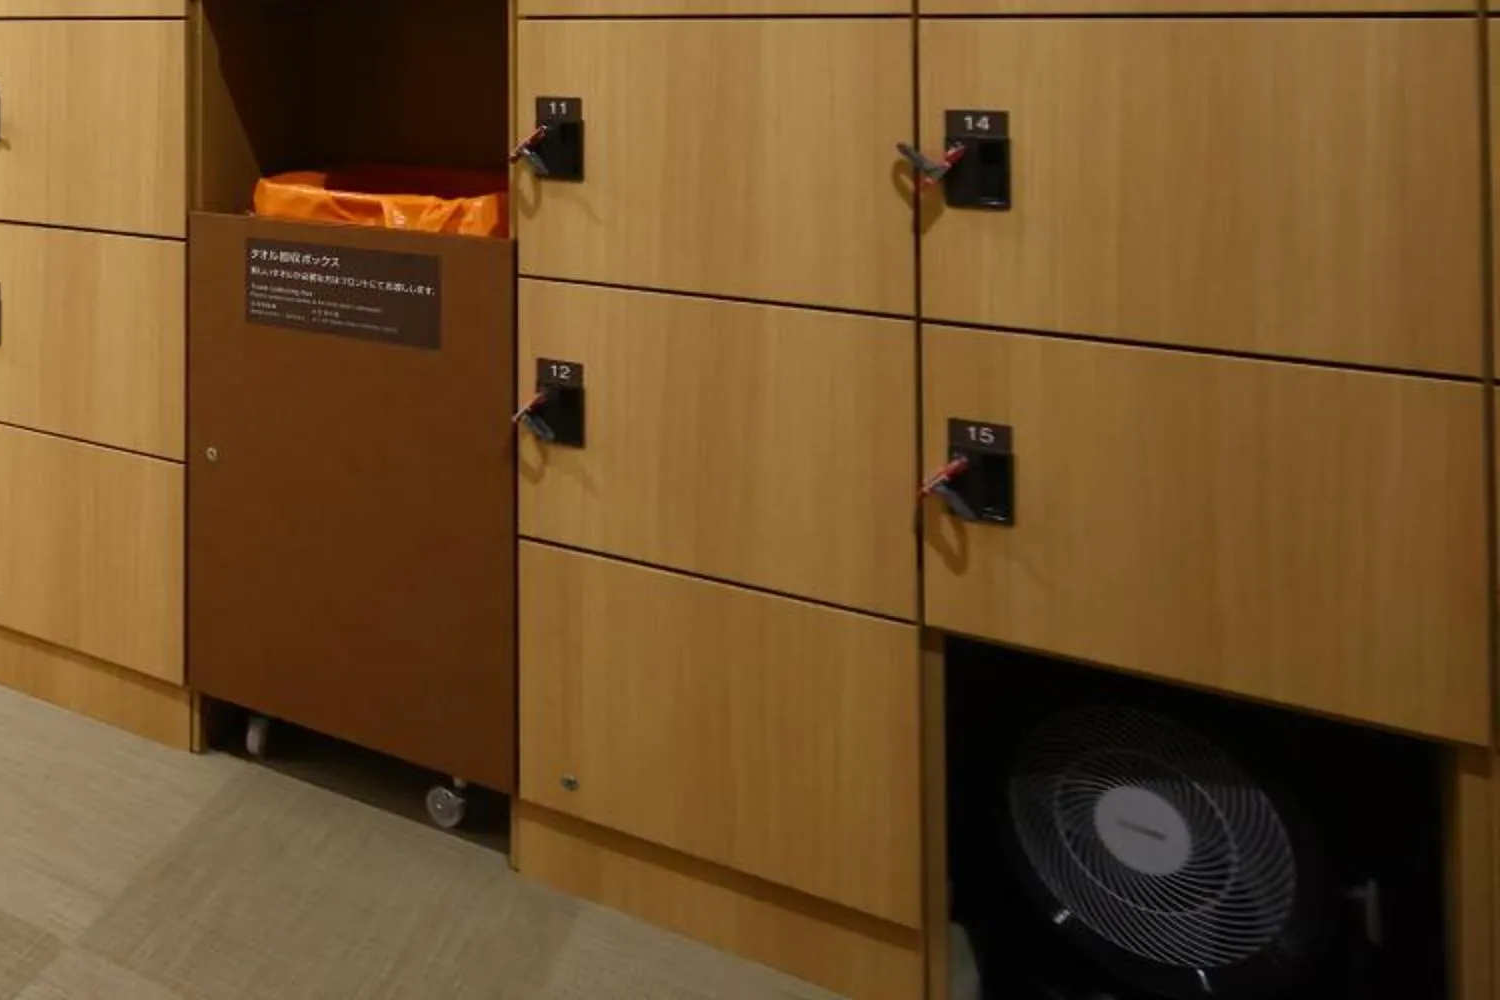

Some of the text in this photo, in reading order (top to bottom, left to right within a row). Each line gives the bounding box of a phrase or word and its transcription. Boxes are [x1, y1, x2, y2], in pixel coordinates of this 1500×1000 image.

[549, 101, 567, 115] 11
[964, 115, 990, 131] 14
[251, 249, 340, 268] タオル回収ボックス
[550, 364, 571, 380] 12
[967, 426, 995, 443] 15
